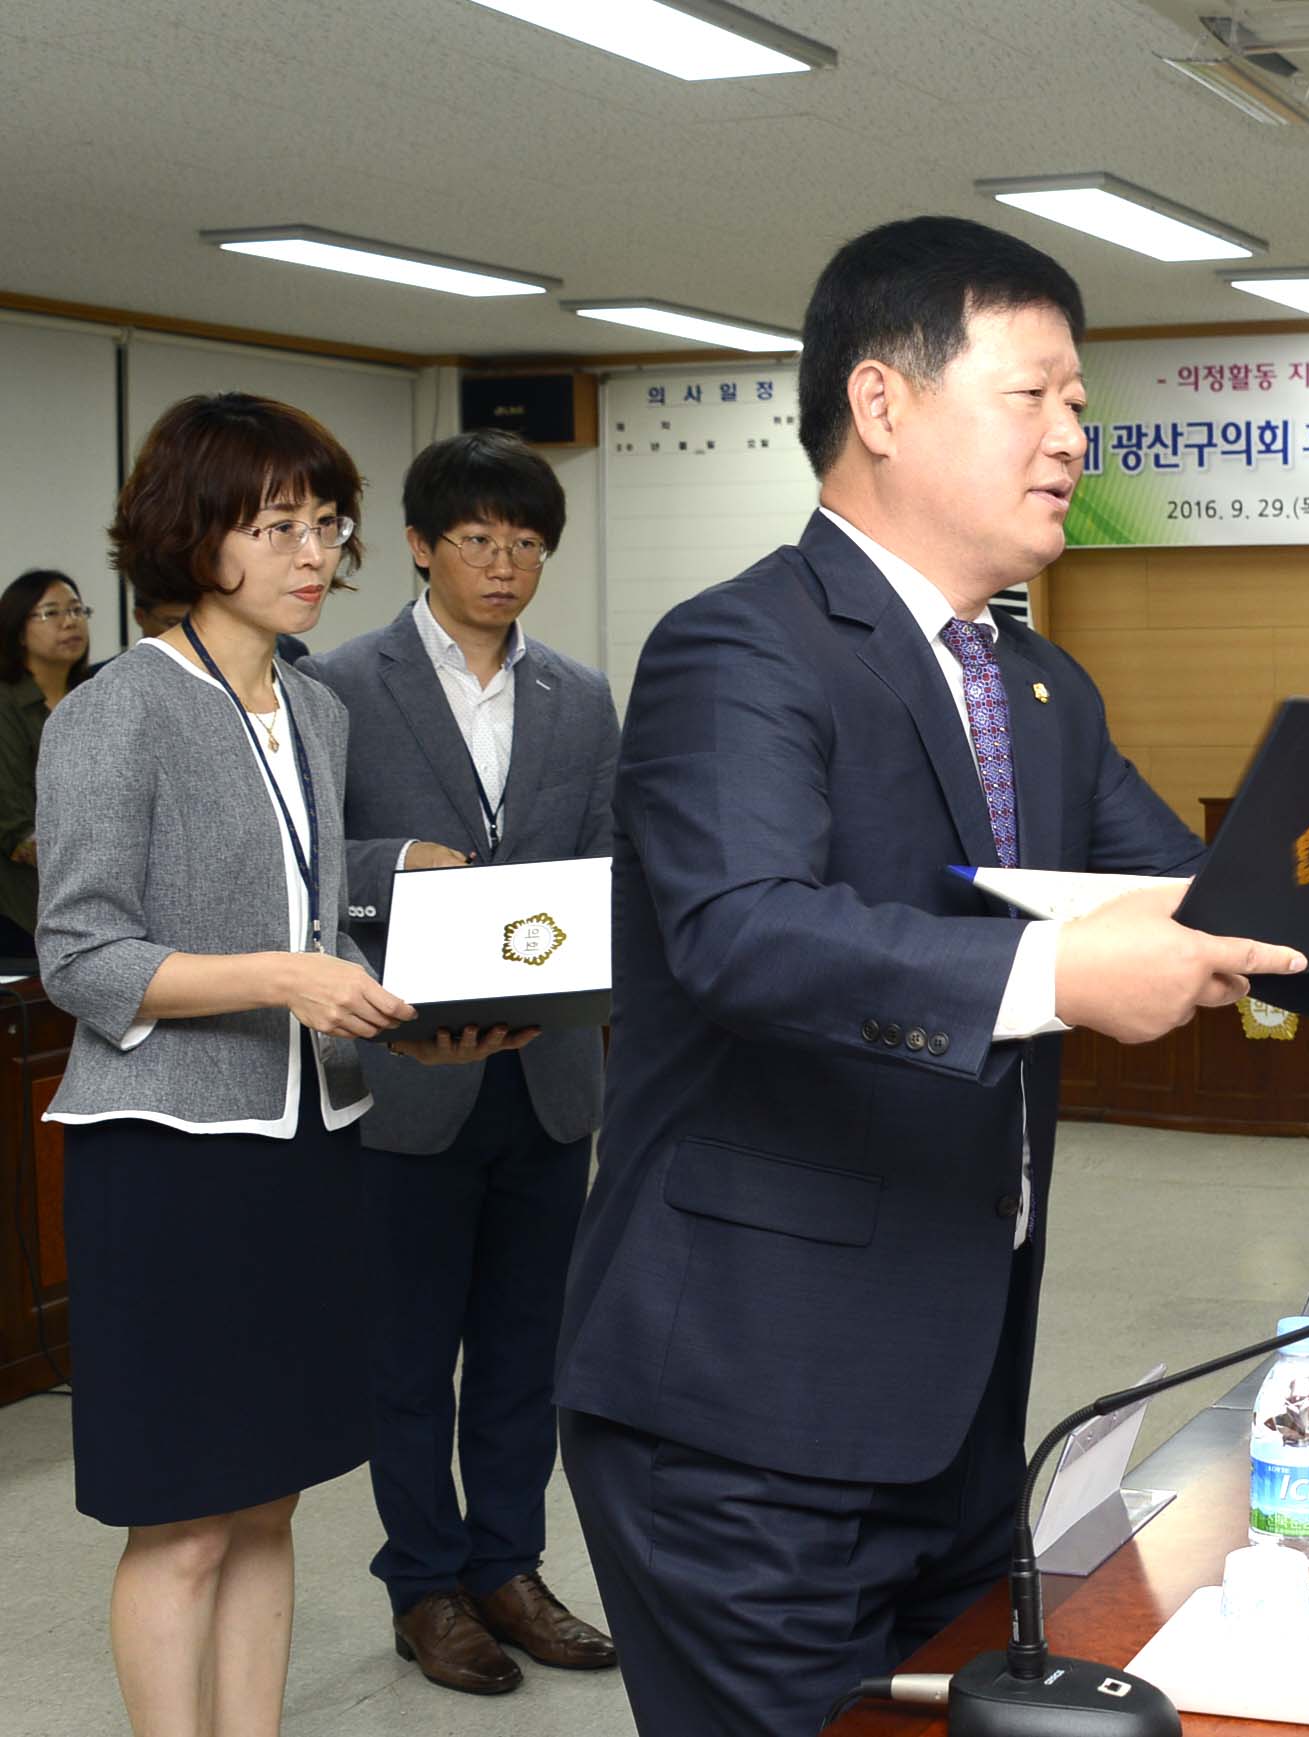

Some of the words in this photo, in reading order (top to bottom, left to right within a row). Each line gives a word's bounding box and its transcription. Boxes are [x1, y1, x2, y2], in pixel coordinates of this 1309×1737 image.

[1177, 362, 1278, 392] 의정활동
[1111, 420, 1289, 471] 광산구의회
[1167, 500, 1224, 520] 2016.
[1231, 501, 1250, 520] 9.
